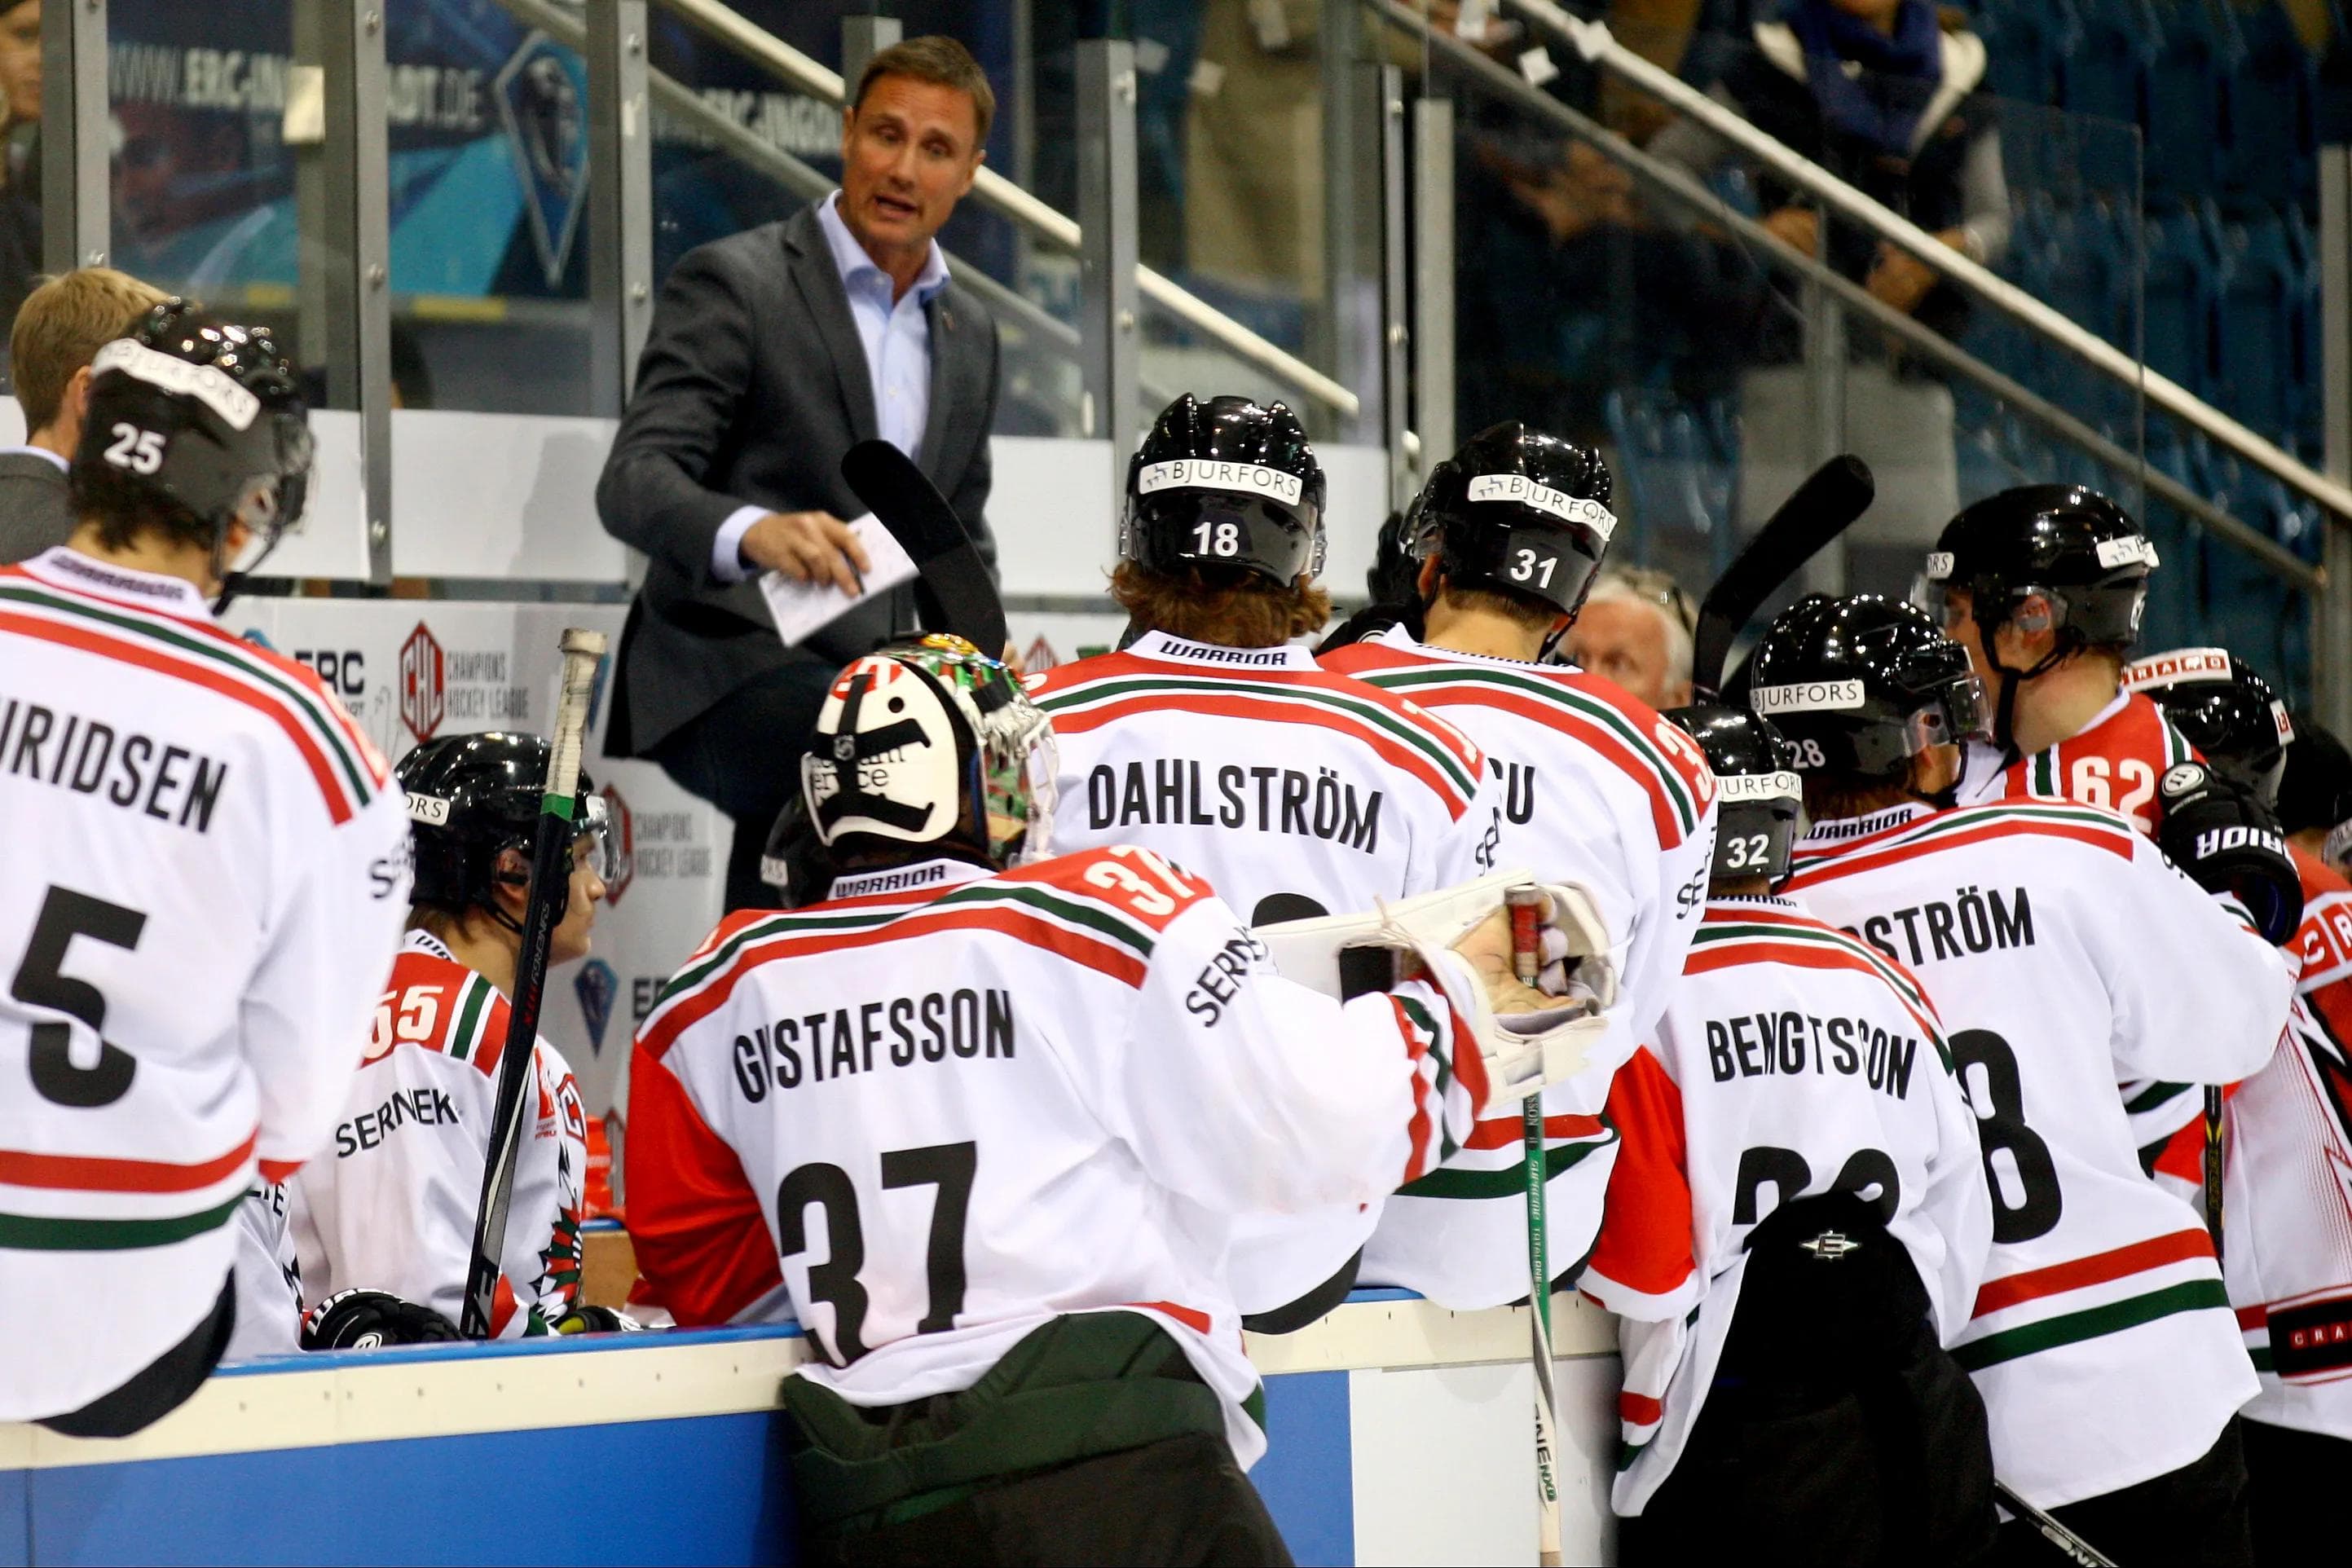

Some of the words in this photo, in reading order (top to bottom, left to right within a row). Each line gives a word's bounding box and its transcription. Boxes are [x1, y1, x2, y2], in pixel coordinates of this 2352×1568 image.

[104, 421, 166, 475] 25
[1173, 460, 1297, 496] BJURFORS
[1510, 477, 1614, 534] BJURFORS
[1192, 522, 1239, 557] 18
[1510, 548, 1558, 589] 31
[447, 652, 506, 682] CHAMPIONS
[1159, 641, 1287, 666] WARRIOR
[2122, 655, 2225, 686] RAMO
[447, 687, 485, 718] HOCKEY
[488, 687, 528, 719] LEAGUE
[1753, 683, 1858, 712] BJURFORS
[1786, 738, 1826, 769] 28
[1087, 759, 1383, 854] DAHLSTRÖM
[2072, 755, 2156, 835] 62
[1804, 808, 1913, 841] WARRIOR
[1727, 834, 1769, 869] 32
[835, 864, 946, 898] WARRIOR
[1083, 844, 1196, 916] 37
[531, 900, 551, 985] SYNERGY
[1839, 885, 2036, 967] STRÖM
[11, 885, 148, 1108] 5
[734, 988, 1015, 1103] GUSTAFSSON
[335, 1089, 460, 1159] SERNEK
[1529, 1160, 1540, 1221] SUPREME
[777, 1141, 978, 1369] 37
